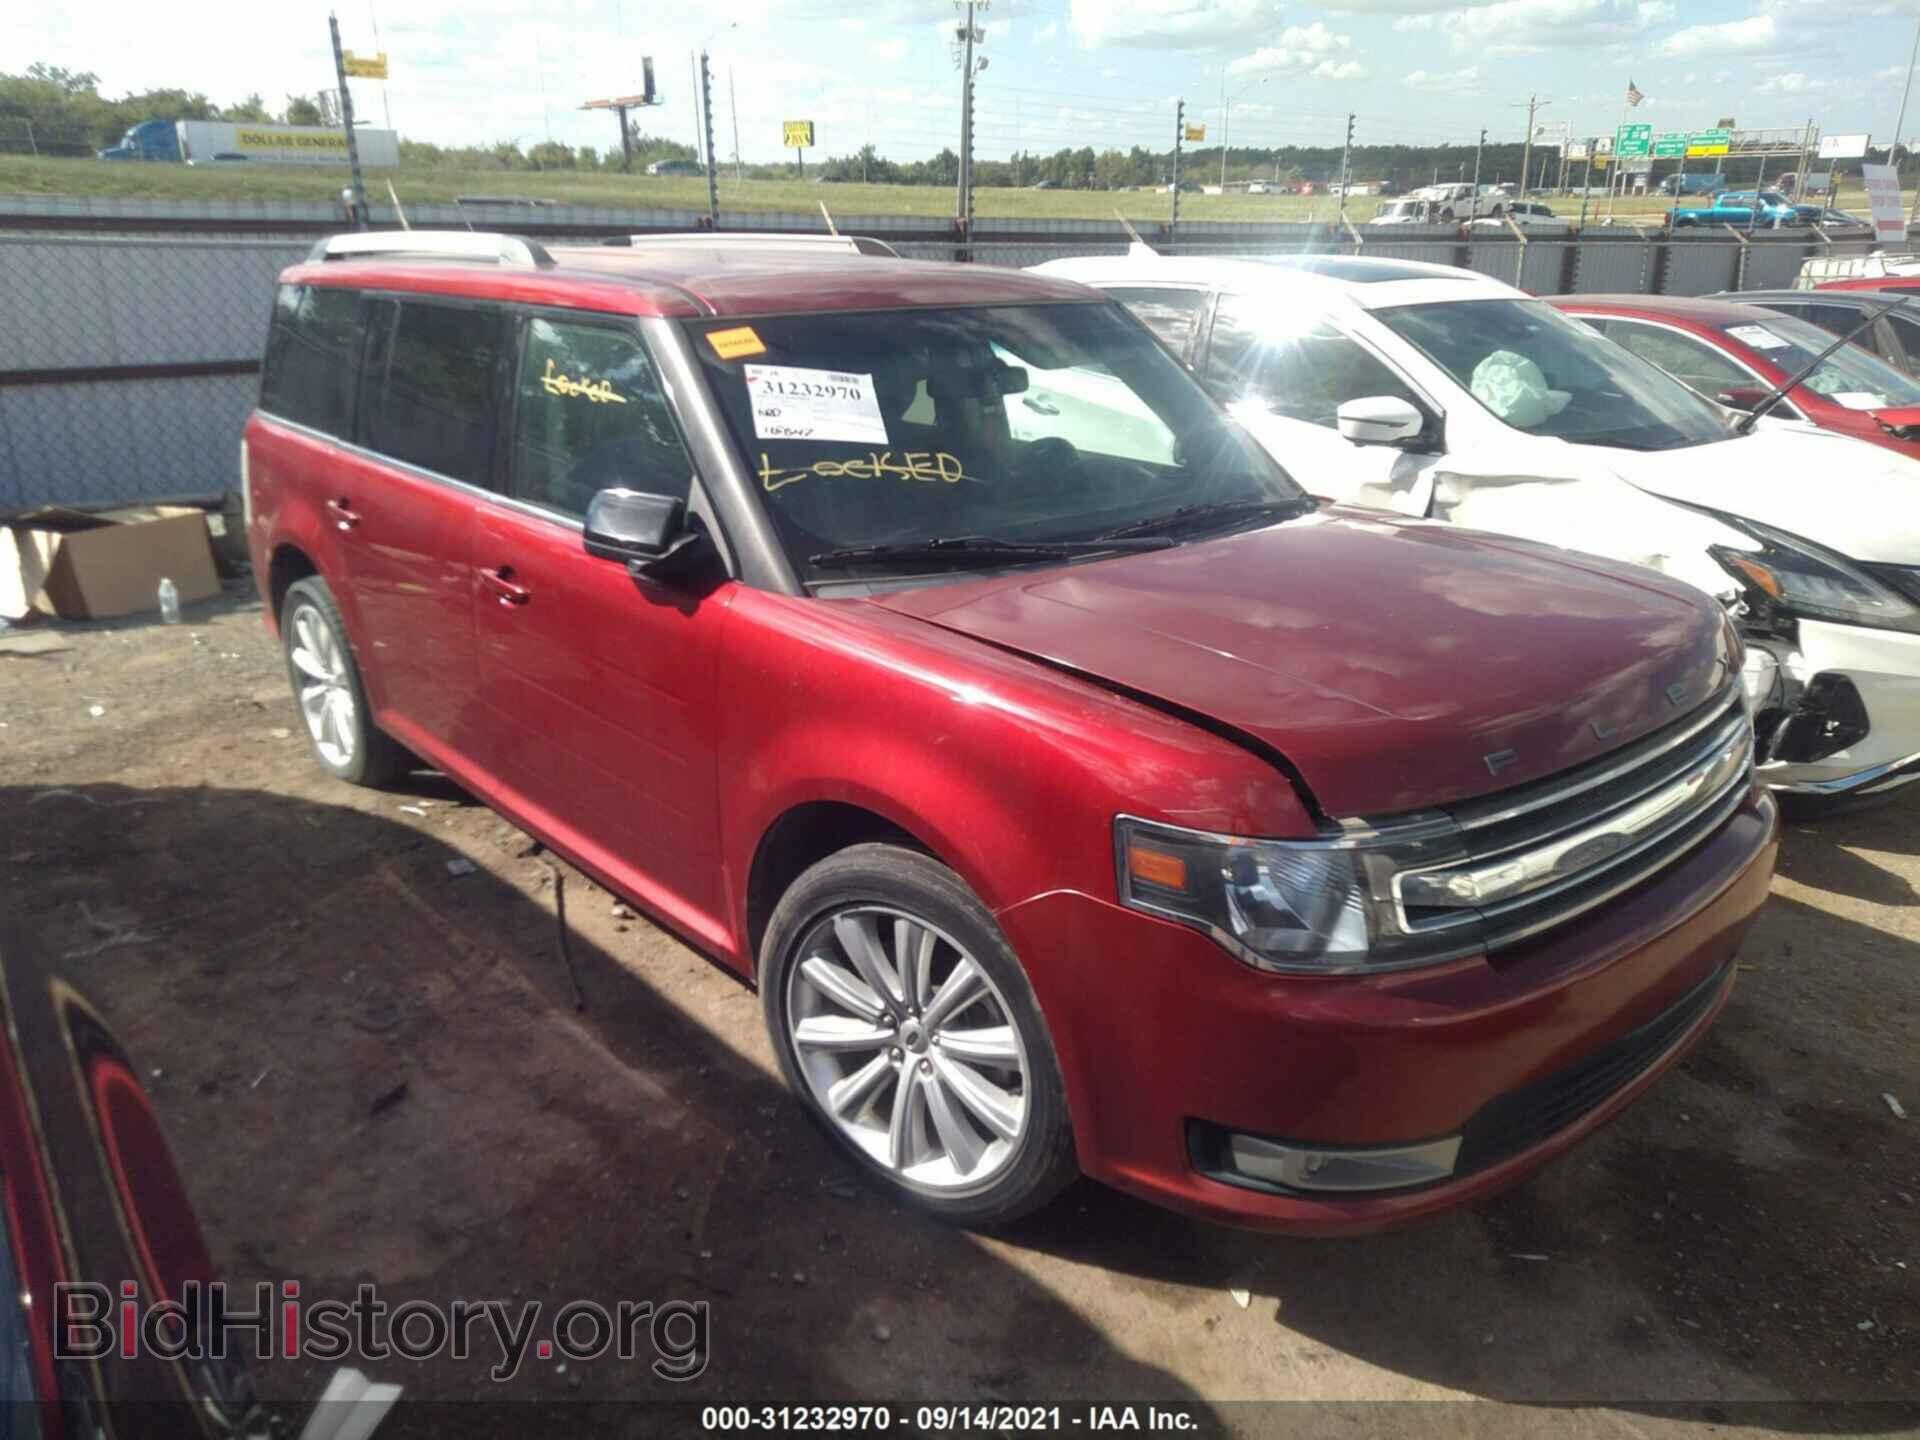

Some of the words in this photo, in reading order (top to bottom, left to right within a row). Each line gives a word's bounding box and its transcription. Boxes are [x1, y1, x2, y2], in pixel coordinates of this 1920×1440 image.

[241, 133, 293, 147] DOLLAR
[296, 134, 347, 148] GENERA
[762, 380, 862, 401] 31232970
[757, 451, 963, 491] LOCKED
